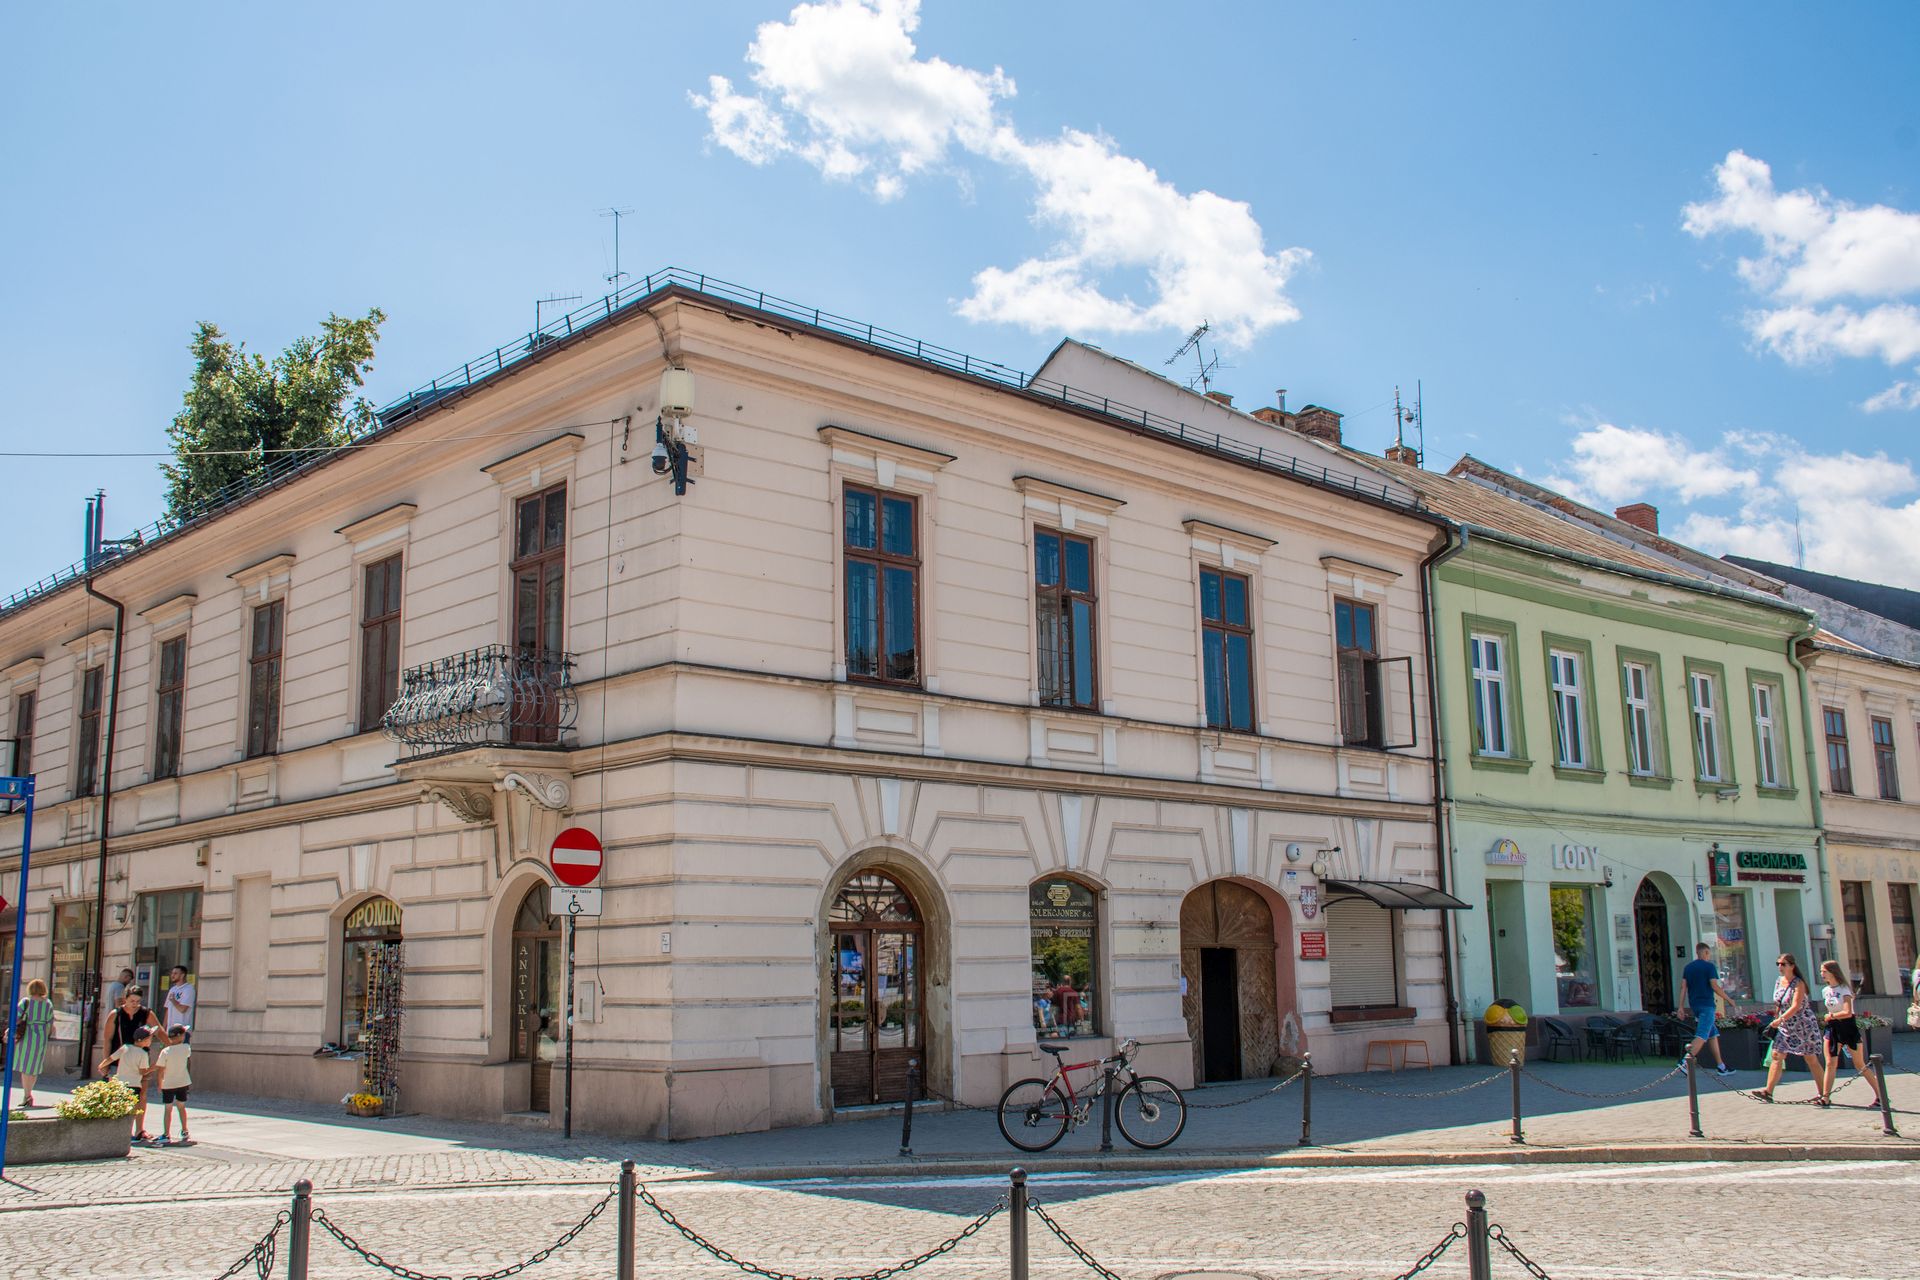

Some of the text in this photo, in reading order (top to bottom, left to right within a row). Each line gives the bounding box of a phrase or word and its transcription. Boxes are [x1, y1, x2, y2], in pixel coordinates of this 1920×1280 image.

[1552, 845, 1599, 871] LODY
[1740, 852, 1807, 869] GROMADA
[1698, 888, 1703, 899] 3
[518, 946, 528, 1030] ANTYKI
